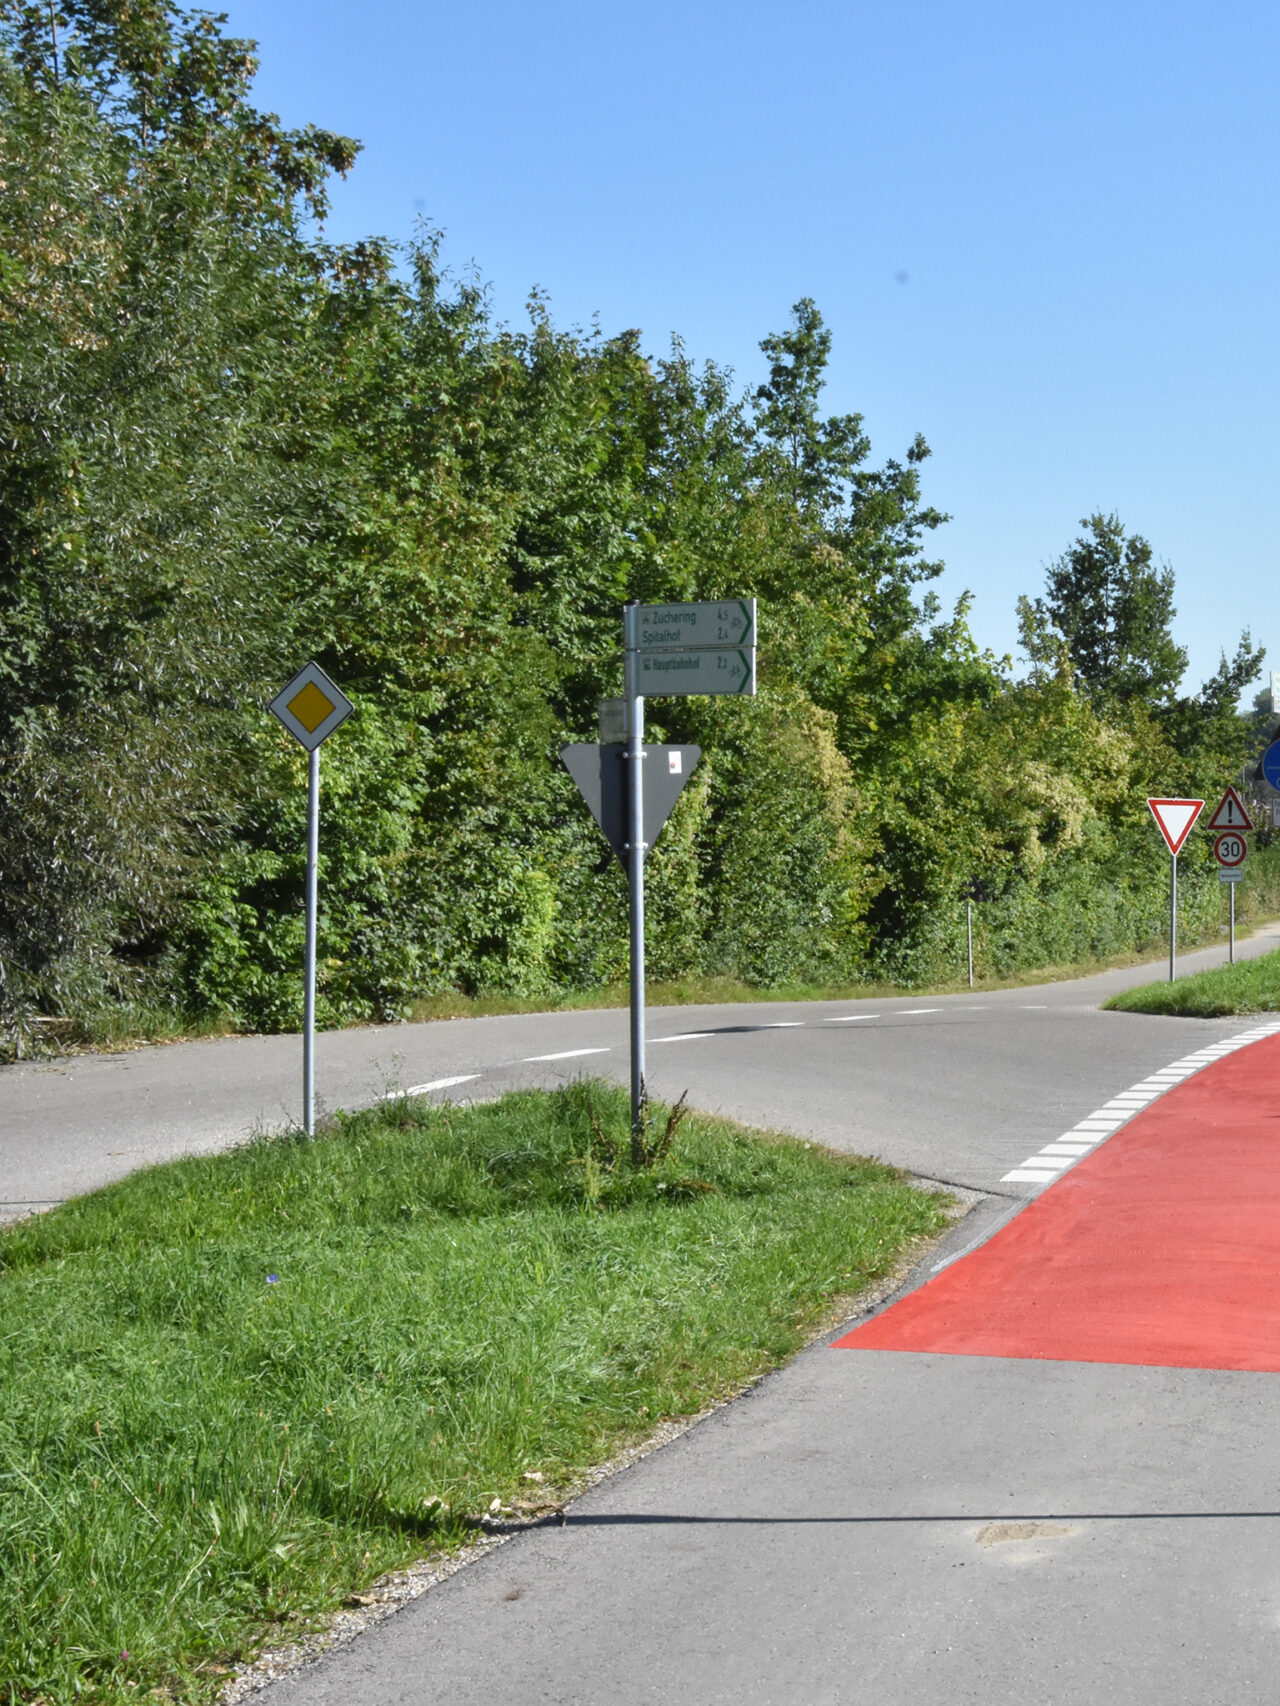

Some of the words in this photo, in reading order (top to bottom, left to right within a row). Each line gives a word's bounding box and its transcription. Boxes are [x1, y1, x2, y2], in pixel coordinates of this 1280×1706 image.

[652, 611, 697, 626] Zuchering
[642, 629, 681, 646] Spitalhof
[1221, 841, 1240, 857] 30
